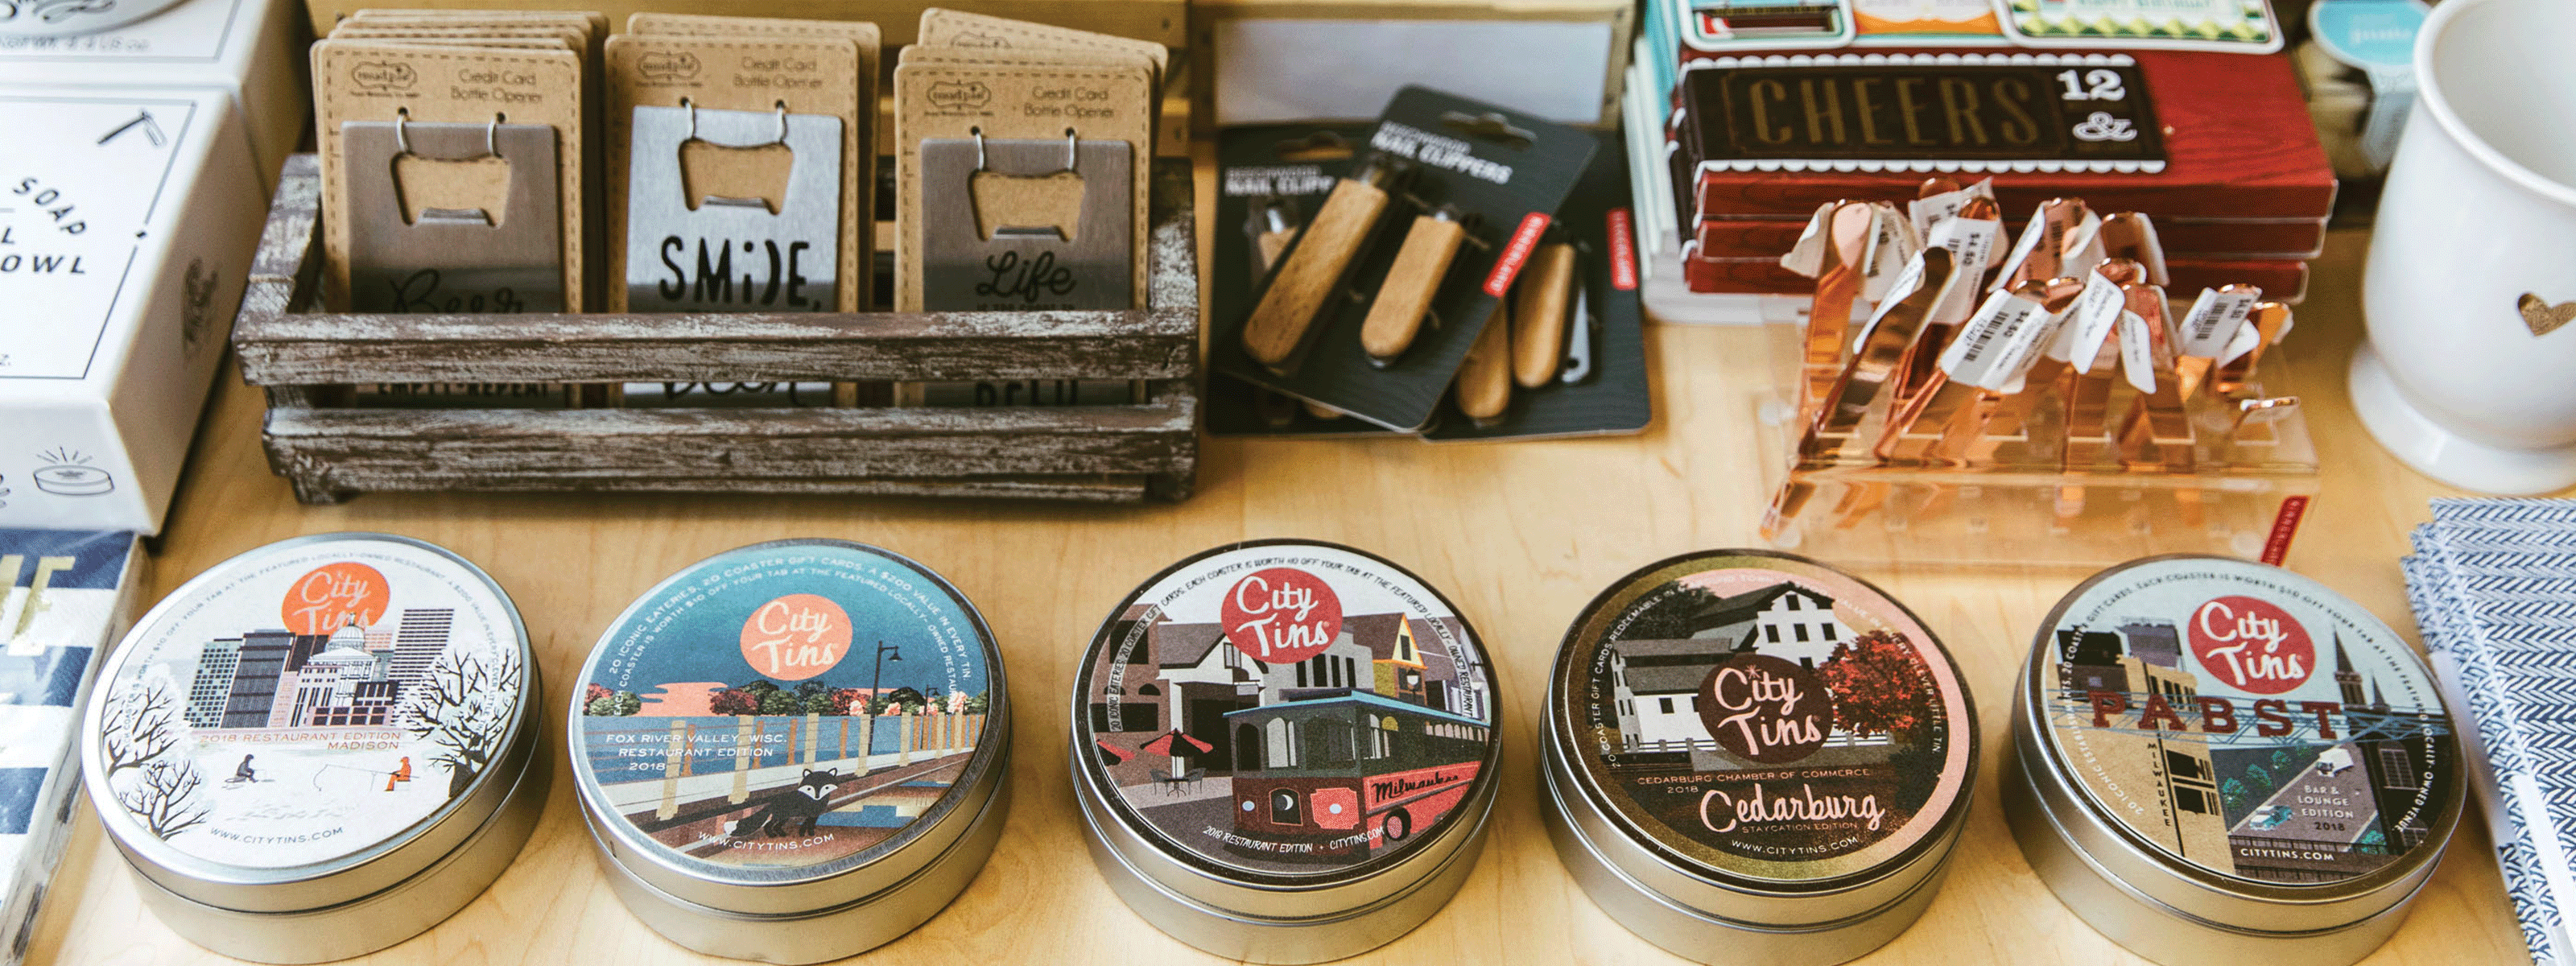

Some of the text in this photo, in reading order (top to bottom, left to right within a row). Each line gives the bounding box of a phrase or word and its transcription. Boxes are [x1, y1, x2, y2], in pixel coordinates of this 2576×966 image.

[741, 56, 818, 72] Credit Card
[458, 68, 537, 86] Credit Card
[733, 74, 823, 89] Bottle Opener
[2056, 68, 2126, 101] 12
[450, 87, 543, 104] Bottle Opener
[1031, 86, 1109, 101] Credit Card
[1023, 102, 1115, 120] Bottle Opener
[1749, 78, 2040, 147] CHEERS
[2071, 110, 2138, 142] &
[1418, 142, 1513, 185] CLIPPERS
[12, 177, 88, 237] SOAP
[975, 250, 1078, 303] Life
[1245, 560, 1253, 568] IS
[1253, 557, 1285, 568] WORTH
[1300, 557, 1320, 565] OFF
[1321, 559, 1344, 570] YOUR
[733, 572, 763, 586] YOUR
[767, 568, 789, 577] TAB
[792, 567, 806, 575] AT
[1206, 563, 1243, 580] COASTER
[1345, 565, 1361, 576] TAB
[1361, 571, 1375, 580] AT
[2165, 571, 2215, 582] COASTER
[300, 569, 372, 609] City
[708, 583, 728, 597] OFF
[1185, 575, 1207, 591] EACH
[1374, 576, 1393, 591] THE
[2135, 576, 2164, 590] EACH
[2233, 574, 2277, 590] WORTH
[2278, 584, 2300, 598] $10
[1236, 576, 1319, 622] City
[1390, 584, 1429, 615] FEATURED
[183, 603, 204, 620] YOUR
[291, 600, 374, 636] Tins
[609, 658, 621, 674] 20
[617, 623, 647, 657] ICONIC
[645, 585, 702, 624] EATERIES.
[703, 574, 720, 586] 20
[724, 557, 784, 578] COASTER
[868, 567, 877, 575] A
[880, 570, 912, 592] $200
[913, 588, 941, 616] VALUE
[938, 615, 951, 627] IN
[946, 626, 968, 658] EVERY
[960, 660, 972, 682] TIN.
[653, 605, 685, 634] WORTH
[1146, 604, 1162, 619] GIFT
[1608, 595, 1663, 642] REDEEMABLE
[2085, 603, 2106, 622] GIFT
[2326, 607, 2355, 630] YOUR
[758, 600, 833, 643] City
[2199, 601, 2289, 654] City
[644, 634, 654, 644] IS
[928, 624, 949, 654] OWNED
[1124, 617, 1149, 650] COASTER
[1235, 612, 1330, 658] Tins
[750, 634, 837, 674] Tins
[1121, 646, 1131, 658] 20
[1448, 644, 1467, 672] OWNED
[1594, 641, 1613, 675] CARDS
[618, 644, 646, 687] COASTER
[2062, 660, 2074, 676] 20
[2205, 641, 2306, 686] Tins
[2384, 655, 2403, 673] THE
[1590, 677, 1601, 700] GIFT
[1714, 664, 1805, 716] City
[613, 690, 626, 716] EACH
[1108, 694, 1119, 720] ICONIC
[2087, 690, 2343, 740] PABST
[1109, 720, 1122, 731] 20
[1591, 701, 1611, 751] COASTER
[1716, 705, 1823, 756] Tins
[200, 731, 402, 744] 2018 RESTAURANT EDITION
[327, 741, 400, 751] MADISON
[605, 733, 787, 744] FOX RIVER VALLEY, WISC.
[1931, 736, 1943, 755] TIN.
[618, 748, 774, 758] RESTAURANT EDITION
[1608, 753, 1621, 769] 20
[628, 762, 667, 771] 2018
[1637, 767, 1871, 786] CEDARBURG CHAMBER OF COMMERCE
[2093, 765, 2129, 803] ICONIC
[2146, 741, 2172, 828] MILWAUKEE
[1371, 771, 1459, 803] Milwaukee
[1666, 785, 1699, 795] 2018
[2303, 785, 2340, 795] BAR &
[2414, 770, 2435, 807] OWNED
[1699, 783, 1886, 832] Cedarburg
[2127, 801, 2145, 815] 20
[2297, 795, 2350, 807] LOUNGE
[2301, 807, 2355, 819] EDITION
[2391, 806, 2421, 833] VENUE.
[210, 826, 344, 844] WWW.CITYTINS.COM
[1741, 821, 1859, 834] STAYCATION EDITION
[2314, 821, 2346, 832] 2018
[697, 831, 835, 851] WWW.CITYTINS.COM
[1203, 824, 1385, 853] 2018 RESTAURANT EDITION CITYTINS.COM
[1731, 836, 1860, 856] WWW.CITYTINS.COM
[2240, 848, 2335, 861] CITYTINS.COM
